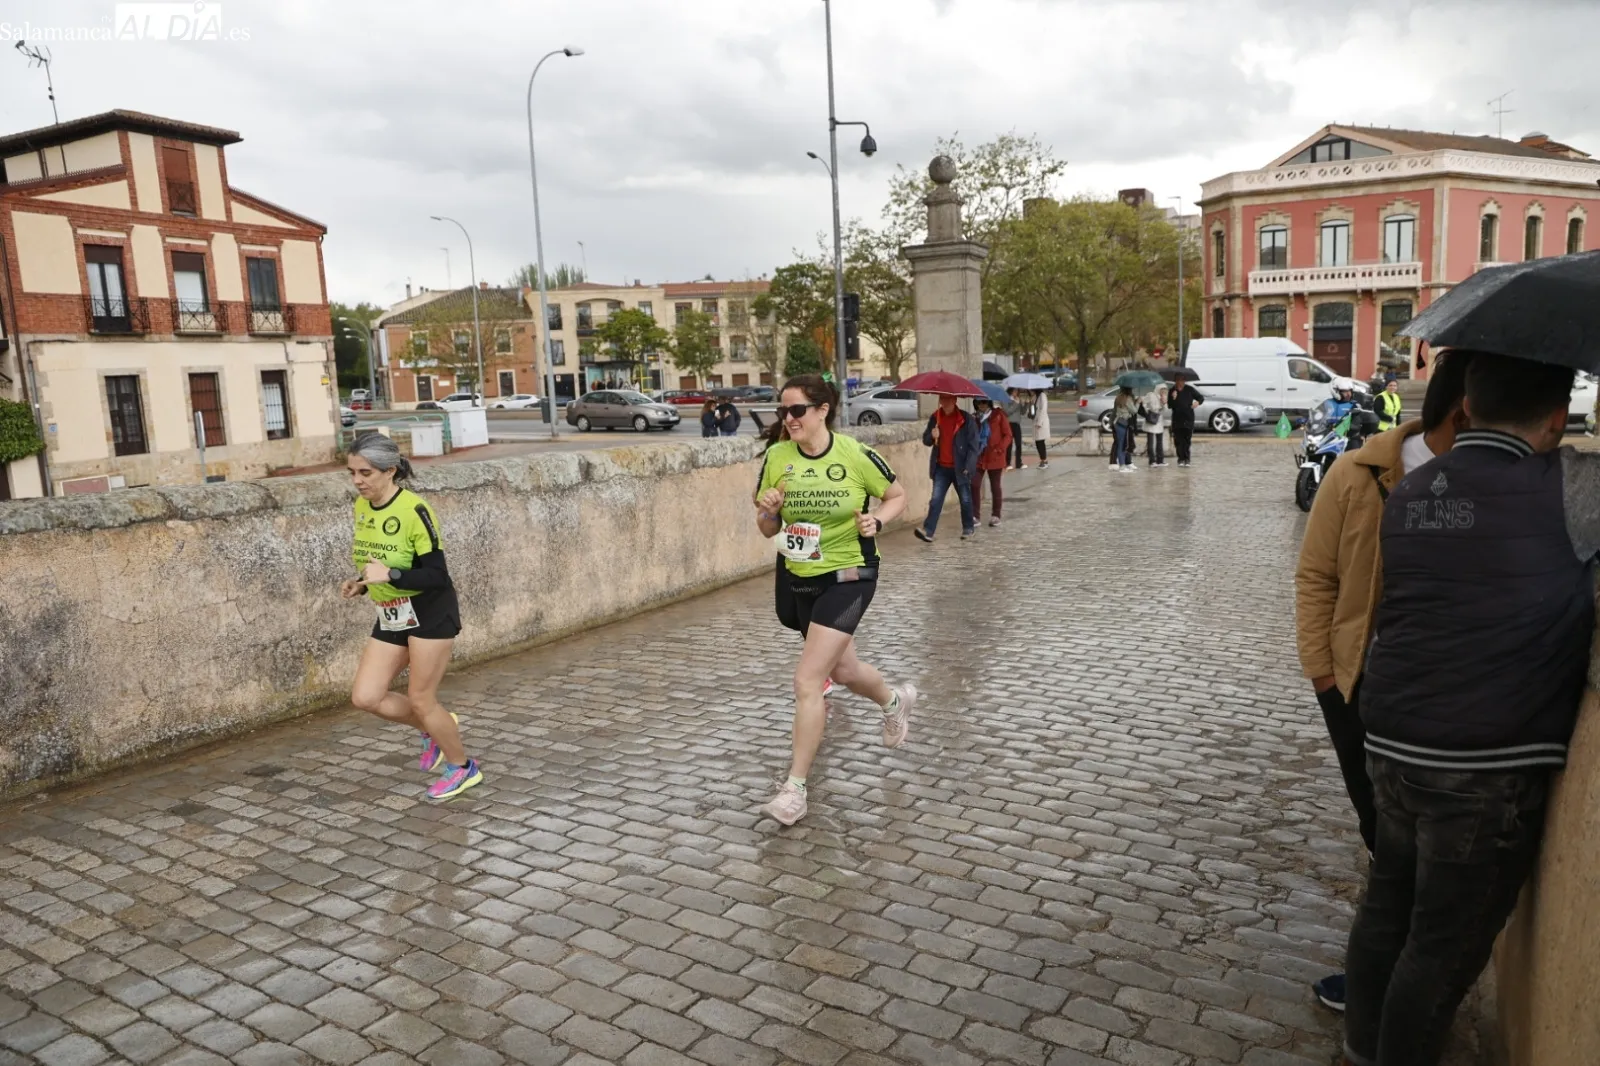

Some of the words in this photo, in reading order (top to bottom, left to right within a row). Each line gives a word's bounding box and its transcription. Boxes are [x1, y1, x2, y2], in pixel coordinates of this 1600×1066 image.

[782, 500, 840, 508] CARBAJOSA
[1405, 499, 1474, 529] PLNS
[787, 534, 805, 551] 59
[383, 607, 398, 621] 69
